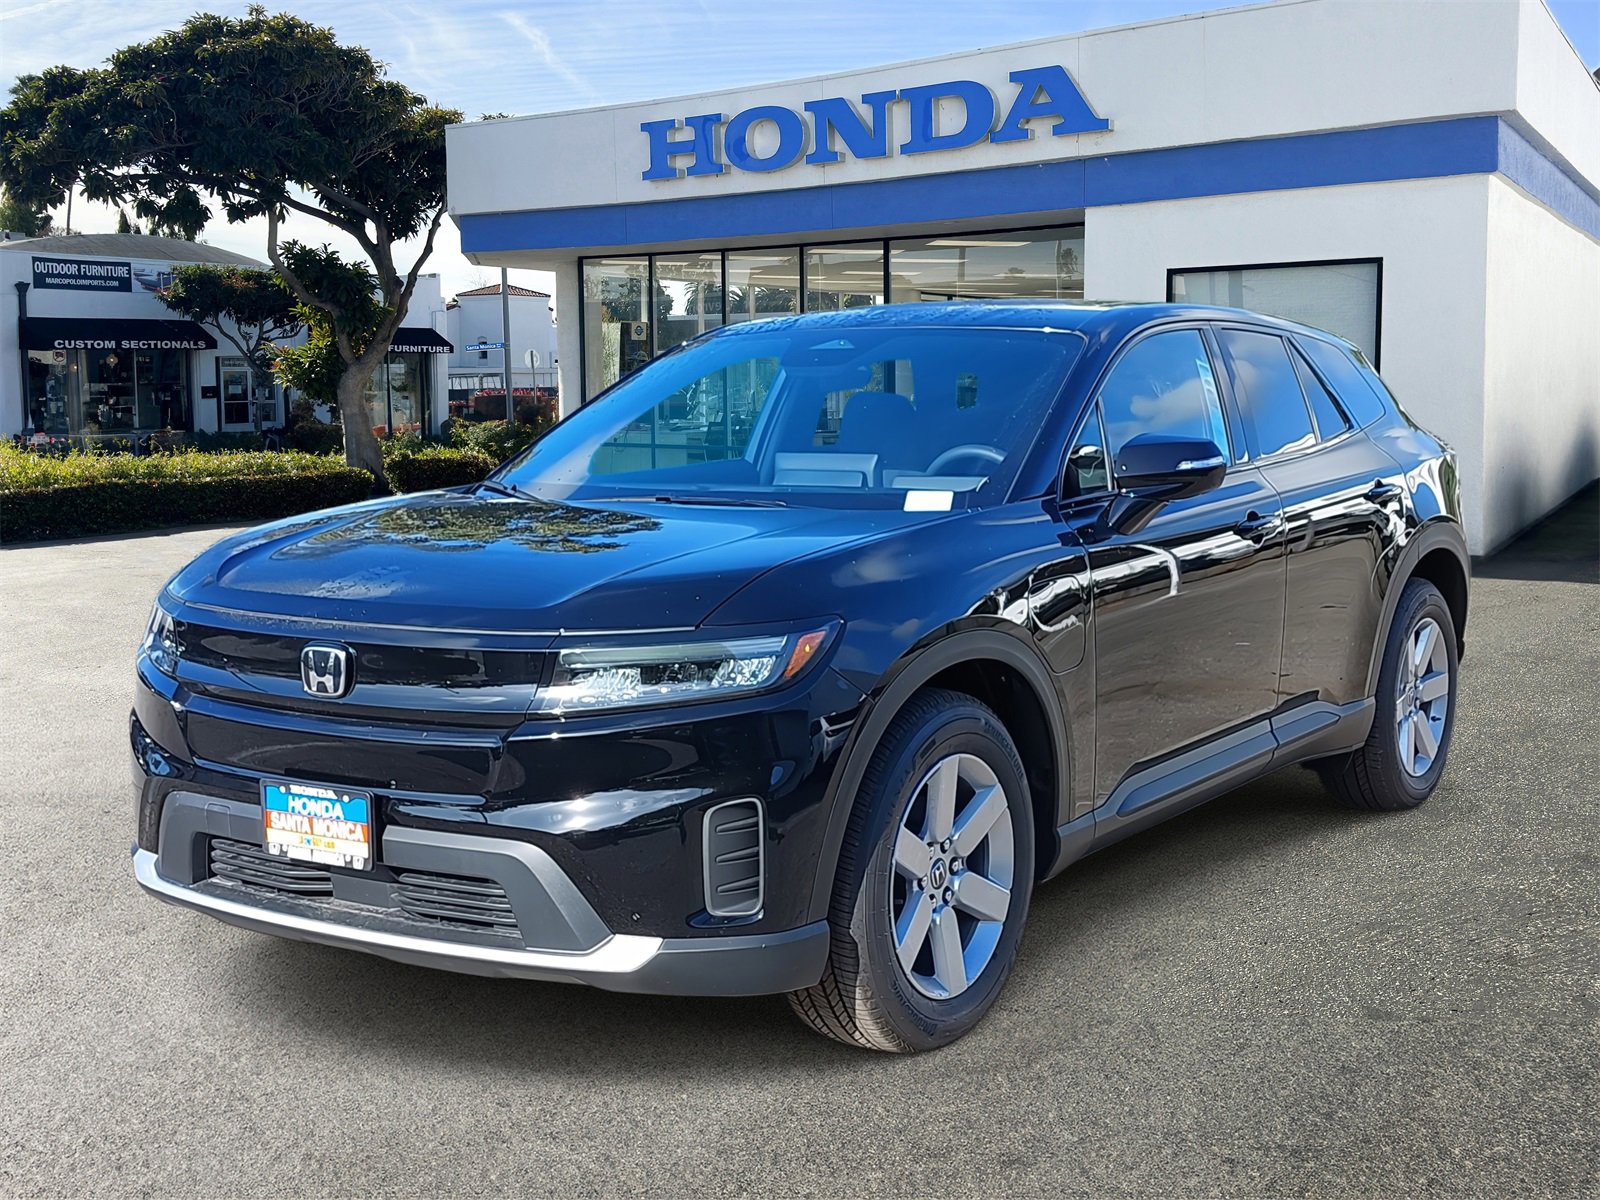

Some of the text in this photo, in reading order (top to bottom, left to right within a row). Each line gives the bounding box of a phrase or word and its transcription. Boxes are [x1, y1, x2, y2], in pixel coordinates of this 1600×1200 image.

[640, 64, 1112, 181] HONDA
[34, 261, 129, 277] OUTDOOR FURNITURE
[45, 277, 119, 287] MARCOPOLOIMPORTS.COM
[54, 340, 206, 349] CUSTOM SECTIONALS
[388, 344, 450, 353] FURNITURE
[288, 795, 345, 820] HONDA
[270, 812, 312, 835] SANTA
[313, 817, 365, 842] MONICA
